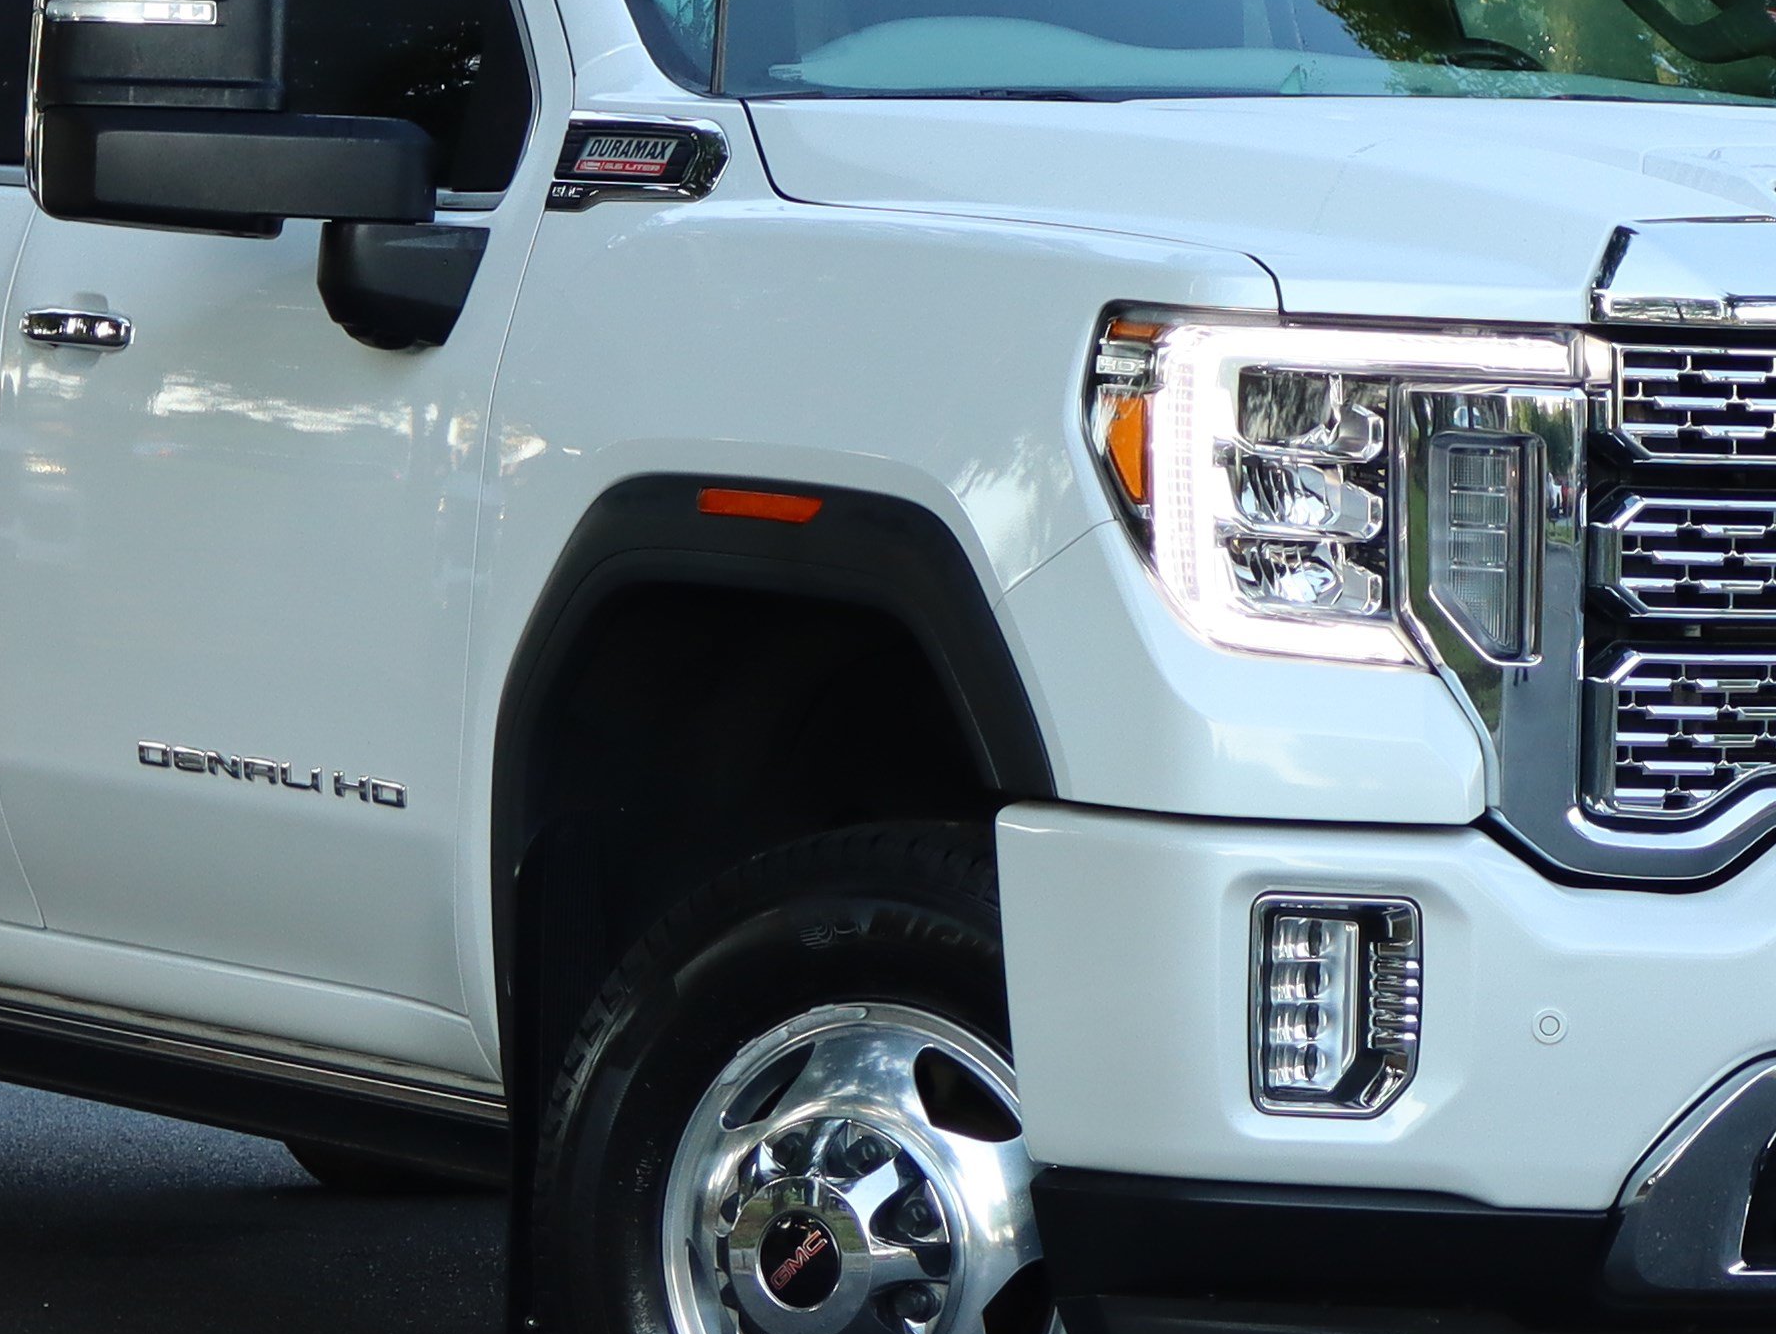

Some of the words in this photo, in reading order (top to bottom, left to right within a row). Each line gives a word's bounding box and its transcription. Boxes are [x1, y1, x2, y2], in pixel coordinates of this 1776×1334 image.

[586, 138, 674, 161] DURAMAX
[137, 739, 323, 793] DENALI
[333, 770, 409, 809] HD
[770, 1228, 828, 1290] GMC
